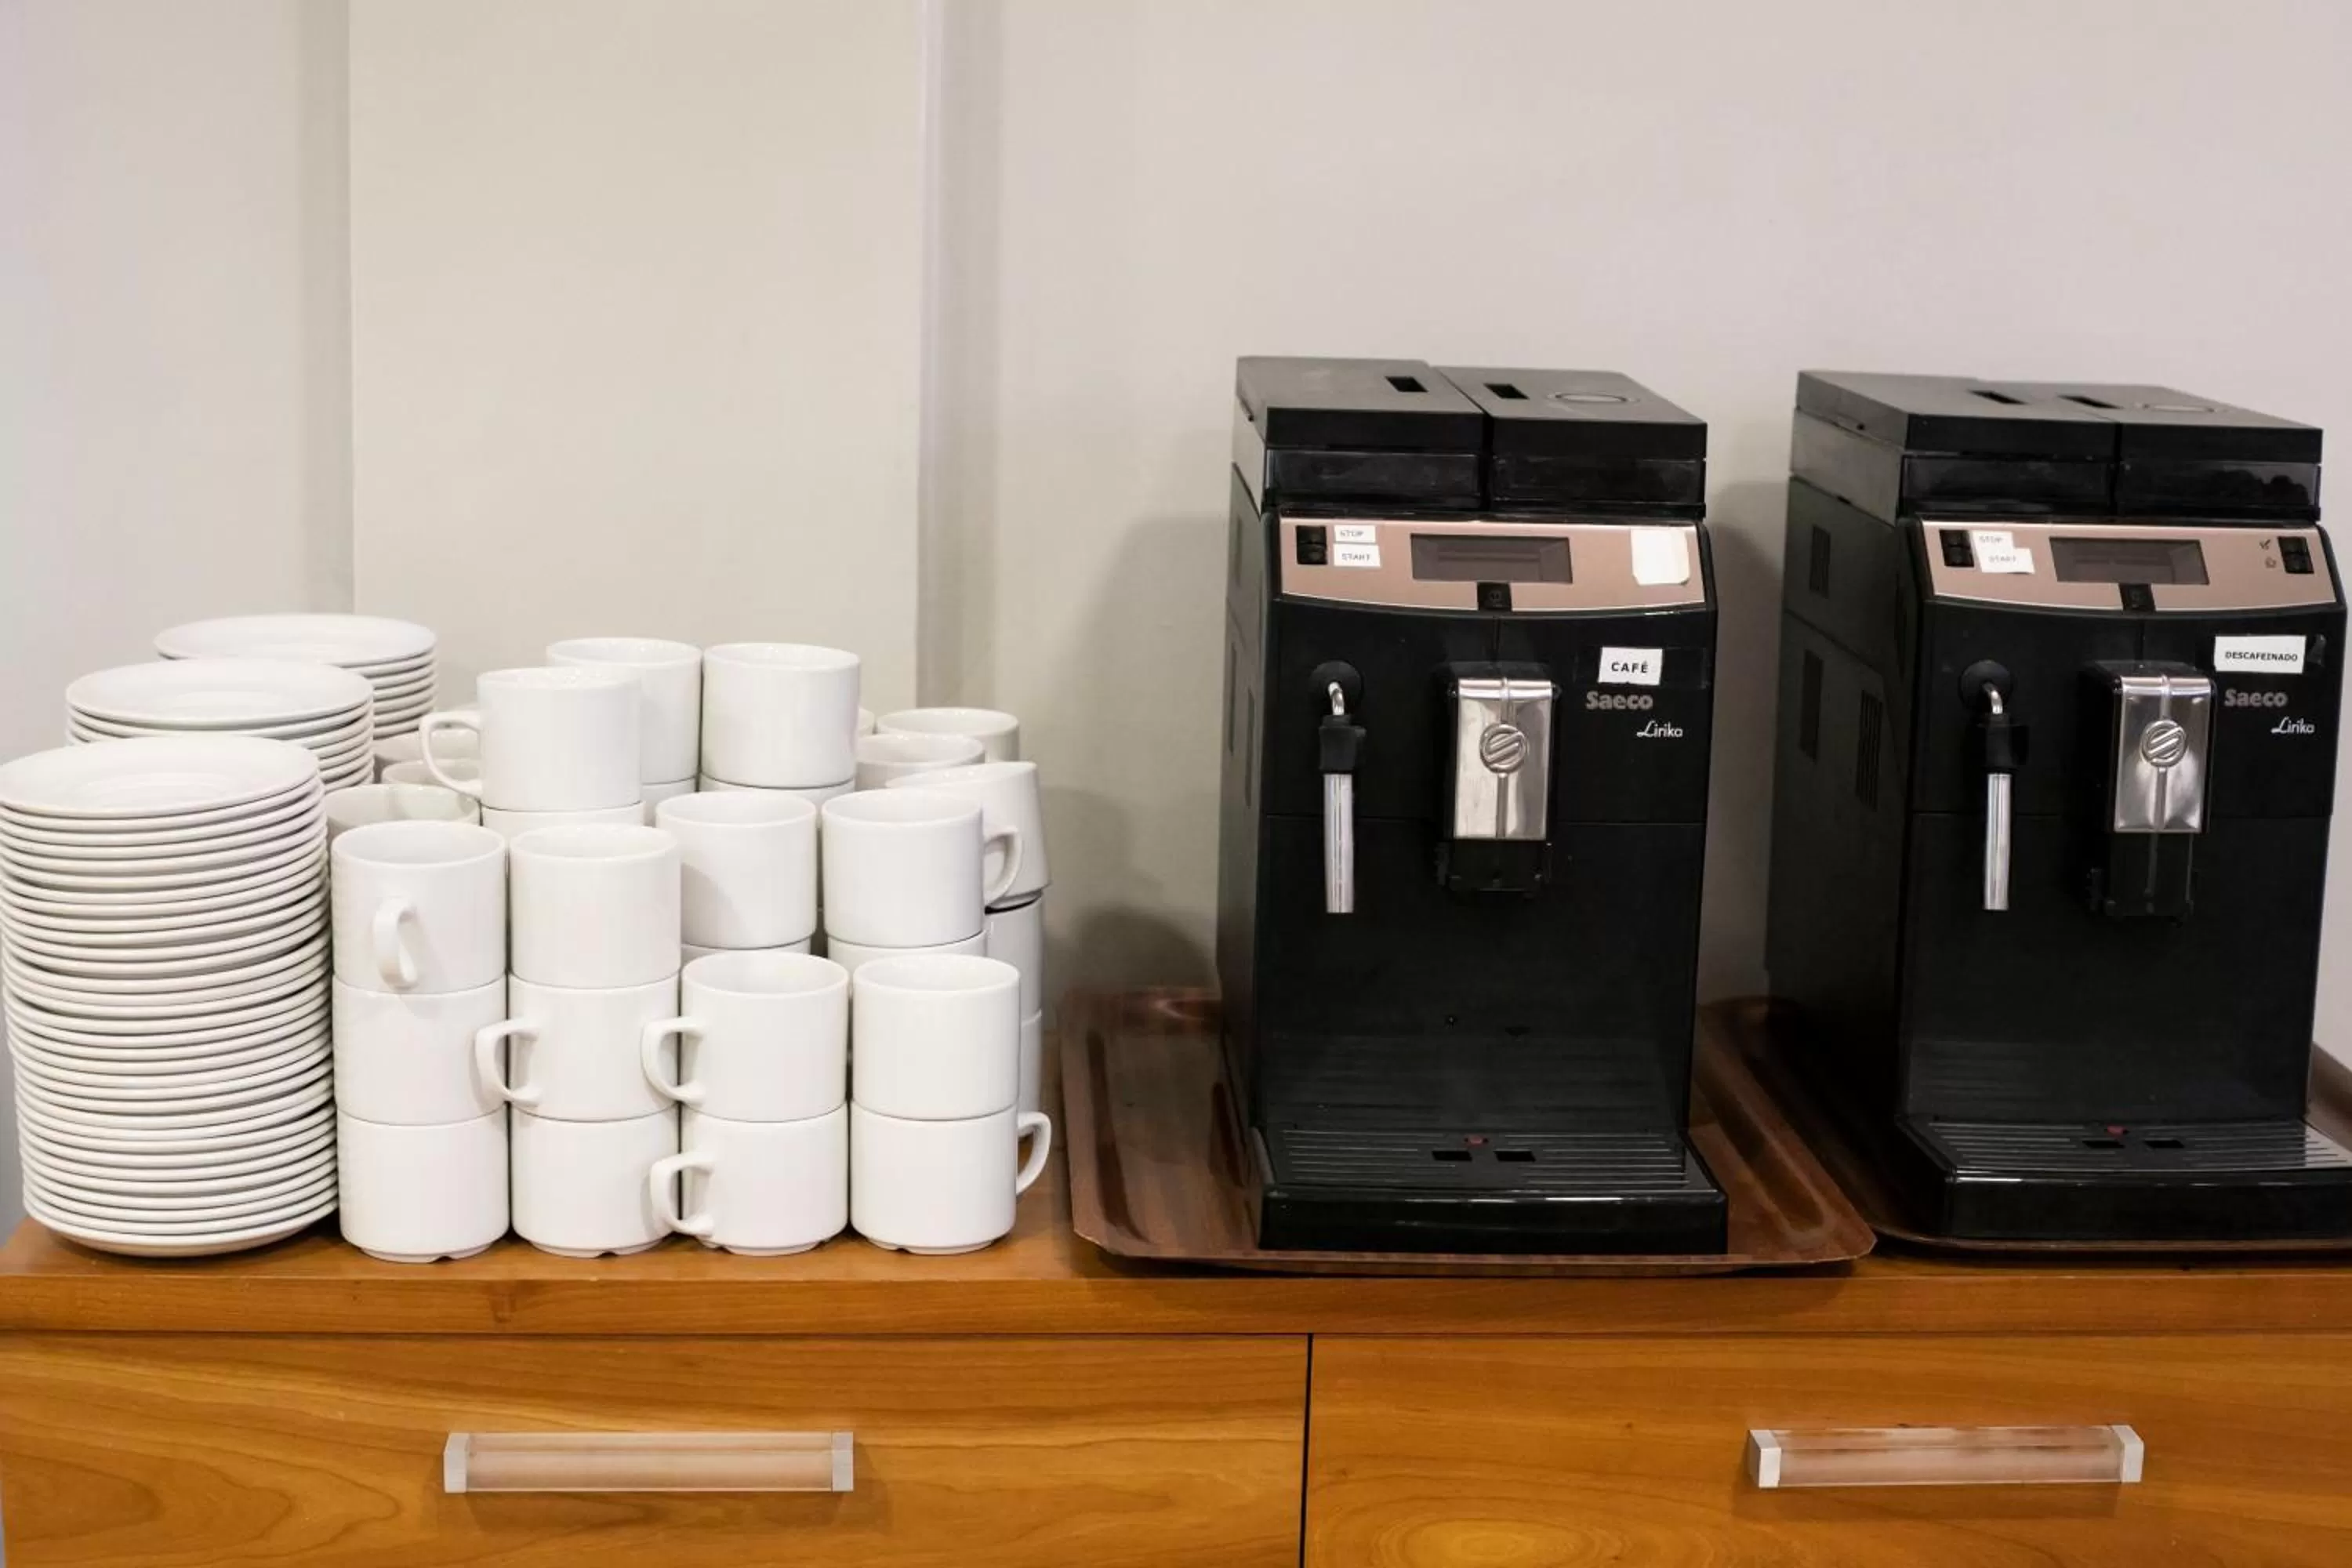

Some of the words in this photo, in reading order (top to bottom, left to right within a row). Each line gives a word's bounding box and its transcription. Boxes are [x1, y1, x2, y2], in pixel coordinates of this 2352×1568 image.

[2225, 651, 2299, 662] DESCAFEINADO
[1611, 660, 1649, 673] CAFÉ
[1585, 690, 1653, 710] Saeco
[2224, 688, 2288, 707] Saeco
[1636, 720, 1683, 738] Lirika
[2270, 716, 2315, 734] Lirika
